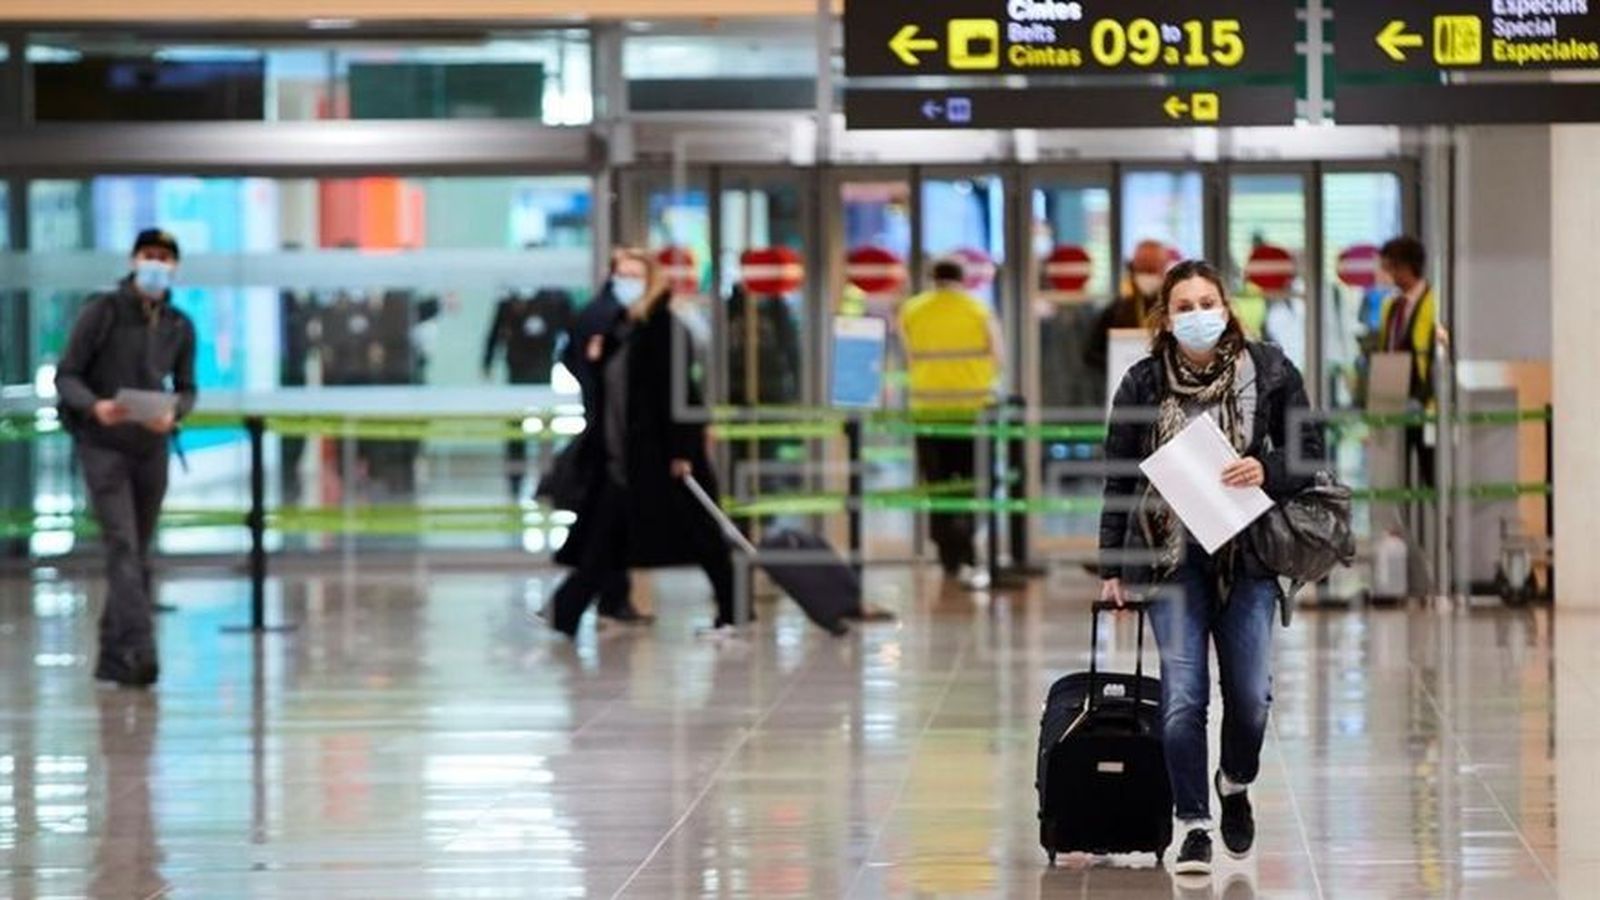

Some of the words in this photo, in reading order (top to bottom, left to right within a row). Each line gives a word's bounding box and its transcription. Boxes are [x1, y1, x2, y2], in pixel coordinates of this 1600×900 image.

[1007, 0, 1082, 21] Cintes
[1493, 0, 1588, 18] Especials
[1007, 22, 1056, 43] Belts
[1493, 17, 1557, 40] Special
[1090, 18, 1161, 66] 09
[1160, 23, 1182, 43] to
[1183, 19, 1244, 66] 15
[1493, 38, 1599, 66] Especiales
[1008, 44, 1082, 67] Cintas
[1163, 46, 1180, 65] a
